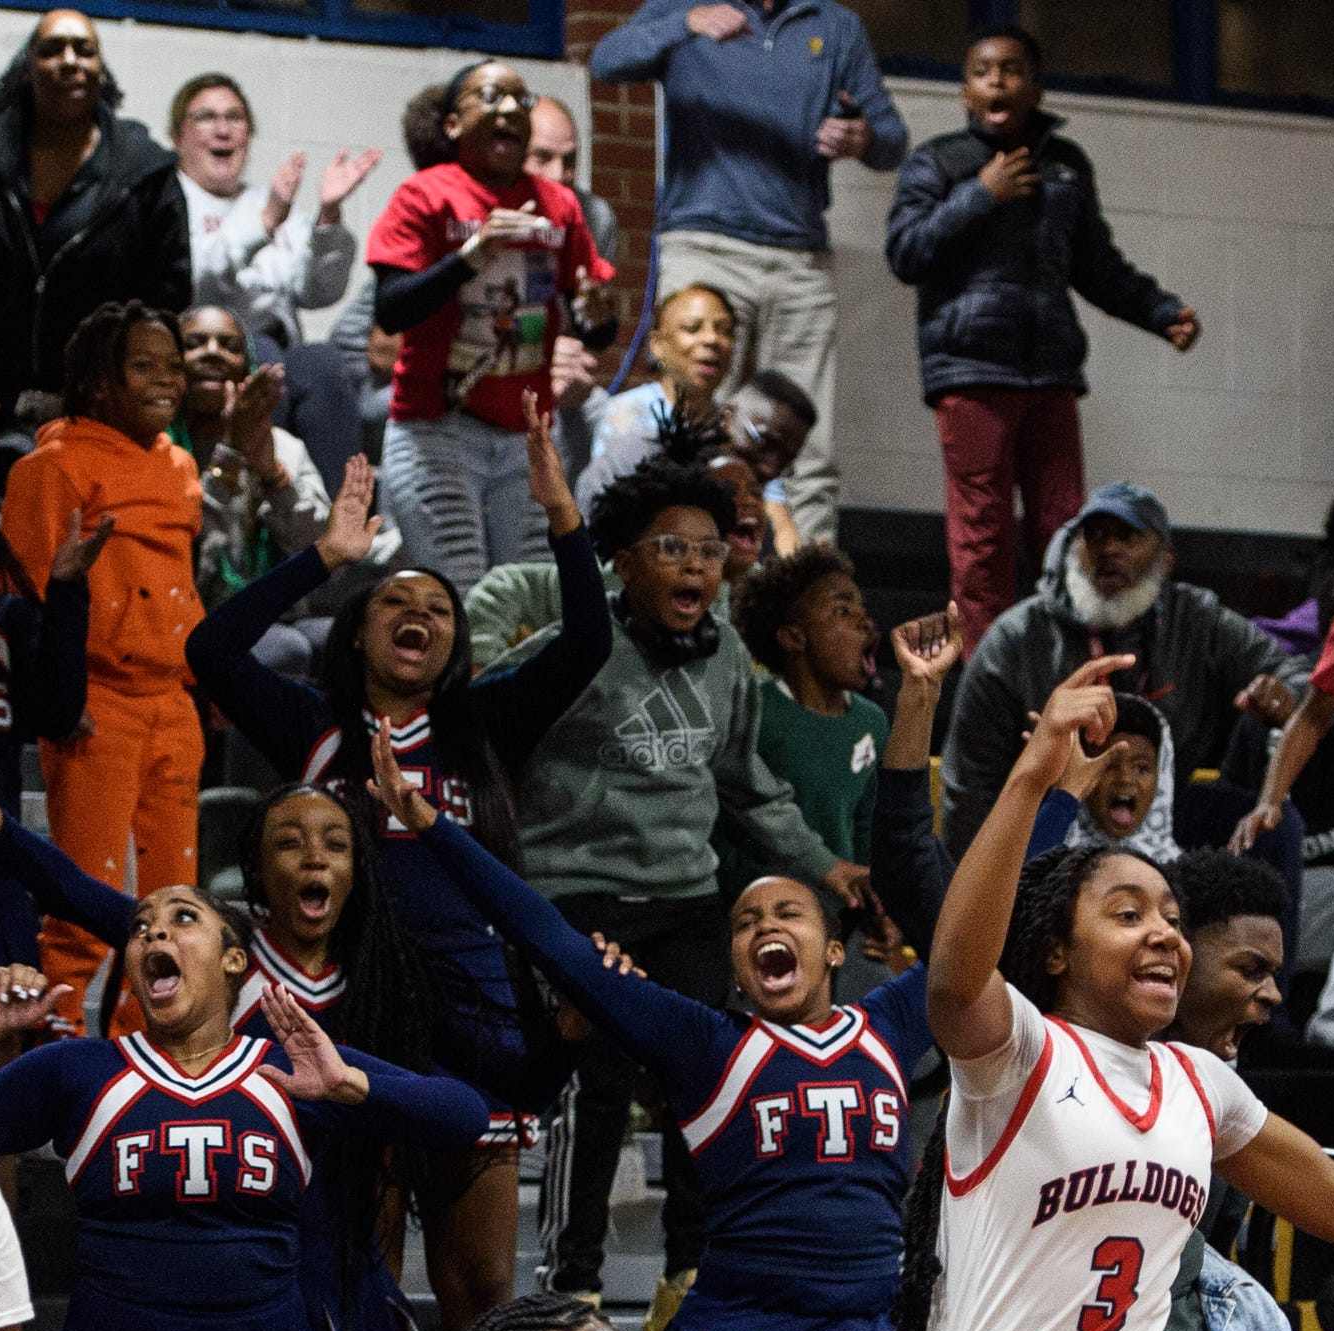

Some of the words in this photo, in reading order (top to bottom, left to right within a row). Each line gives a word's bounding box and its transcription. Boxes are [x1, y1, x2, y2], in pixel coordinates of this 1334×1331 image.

[112, 1119, 279, 1204] FTS
[753, 1080, 903, 1164] FTS
[1032, 1160, 1209, 1230] BULLDOGS
